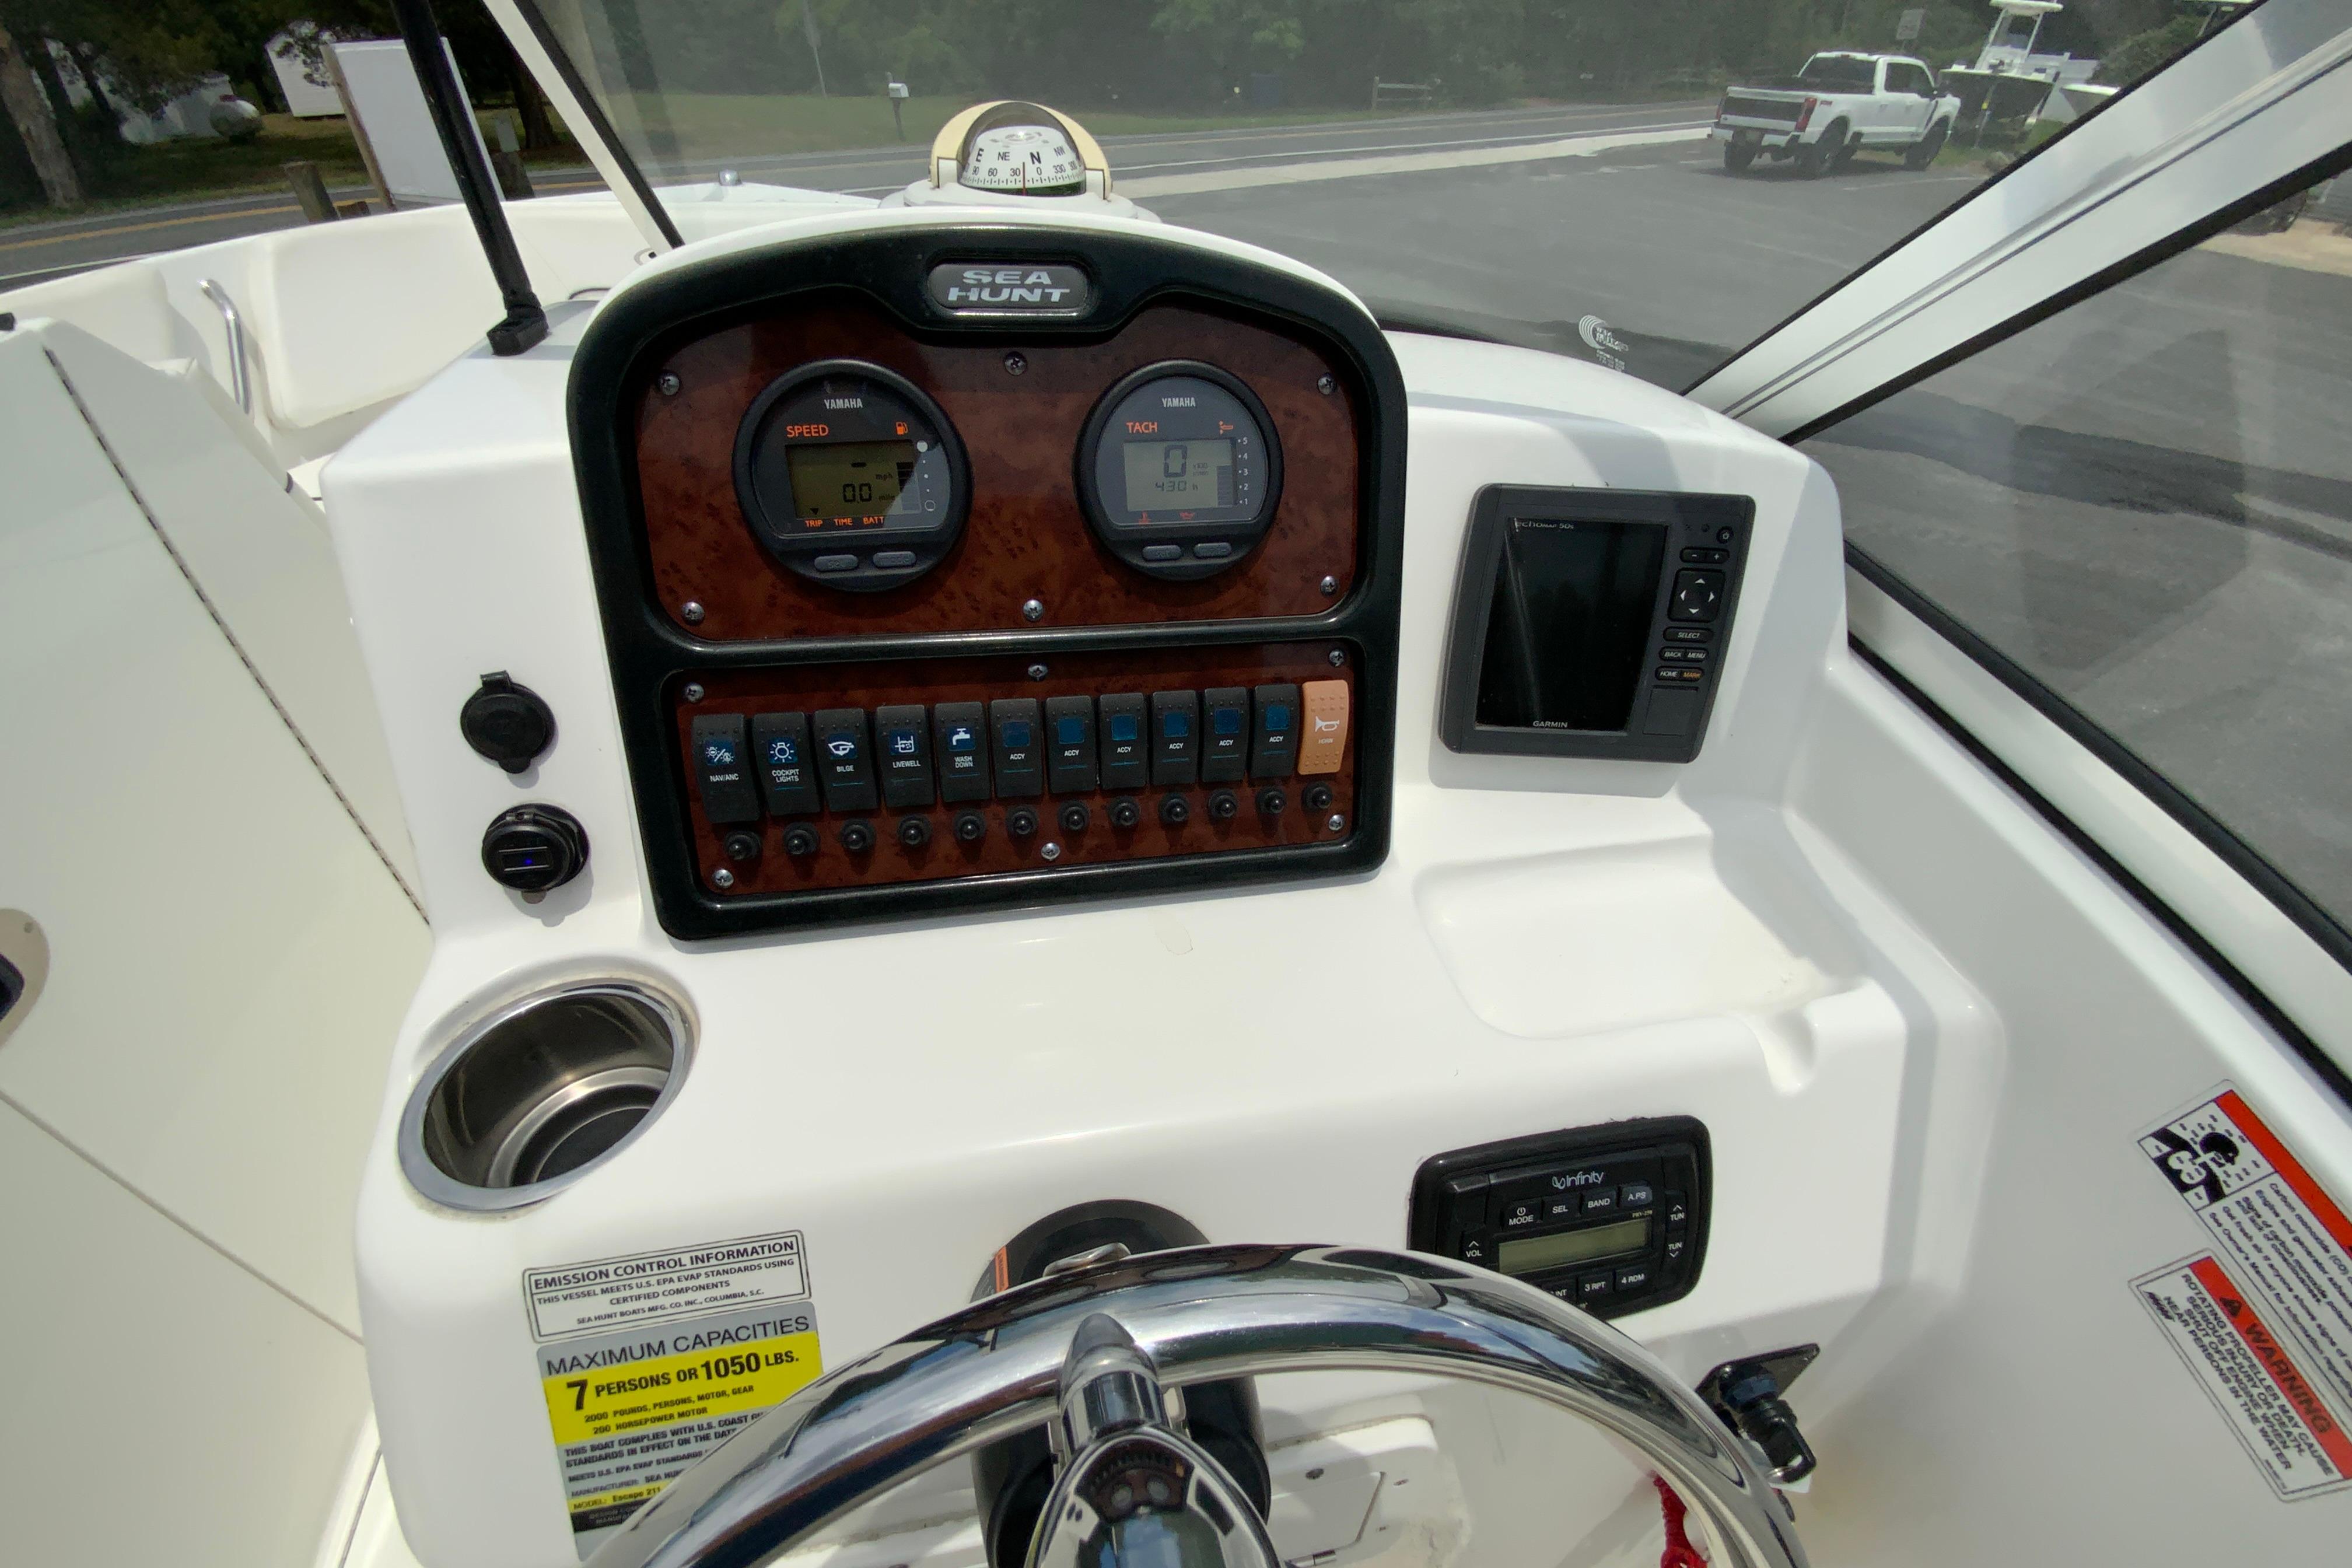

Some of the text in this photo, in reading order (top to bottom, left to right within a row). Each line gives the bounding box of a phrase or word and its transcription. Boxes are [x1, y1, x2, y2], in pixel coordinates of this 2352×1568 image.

[975, 146, 1066, 164] E NE N NW
[972, 166, 979, 176] 90
[988, 168, 998, 177] 60
[1010, 168, 1021, 177] 30
[1037, 167, 1042, 176] 0
[1053, 164, 1066, 174] 330
[963, 270, 1052, 285] SEA
[947, 287, 1070, 302] HUNT
[824, 398, 863, 409] YAMAHA
[1162, 397, 1196, 407] YAMAHA
[786, 424, 829, 438] SPEED
[1126, 421, 1157, 433] TACH
[843, 483, 872, 503] 0.0
[1155, 481, 1187, 492] 430
[805, 516, 884, 527] TRIP TIME BATT
[710, 774, 739, 782] NAV/ANC
[1552, 1205, 1568, 1214] SEL
[1588, 1198, 1610, 1208] BAND
[1508, 1214, 1534, 1226] MODE
[1671, 1212, 1685, 1222] TUN
[1465, 1250, 1482, 1258] VOL
[1668, 1242, 1682, 1251] TUN
[535, 1241, 793, 1289] EMISSION CONTROL INFORMATION
[537, 1259, 794, 1304] THIS VESSEL MEETS U.S. EPA EVAP STANDARDS USING
[1621, 1273, 1645, 1284] 4 RDM
[610, 1280, 730, 1305] CERTIFIED COMPONENTS
[1584, 1281, 1606, 1292] 3 RPT
[594, 1312, 617, 1321] HUNT
[620, 1308, 646, 1317] BOATS
[705, 1292, 748, 1303] COLUMBIA,
[547, 1317, 808, 1375] MAXIMUM CAPACITIES
[2182, 1274, 2226, 1329] ROTATING
[2225, 1332, 2280, 1401] PROPELLER
[2278, 1404, 2301, 1428] MAY
[2188, 1297, 2227, 1346] SERIOUS
[2225, 1348, 2259, 1388] INJURY
[2258, 1392, 2274, 1410] OR
[566, 1350, 799, 1410] 7 PERSONS OR 1050 LBS.
[2164, 1297, 2190, 1327] NEAR
[2189, 1330, 2231, 1384] PERSONS
[2229, 1386, 2242, 1398] IN
[2240, 1401, 2261, 1425] THE
[2259, 1427, 2291, 1469] WATER
[2185, 1309, 2211, 1337] SHUT
[2208, 1341, 2230, 1363] OFF
[2227, 1366, 2262, 1410] ENGINE
[2261, 1413, 2290, 1449] WHEN
[2243, 1320, 2333, 1436] WARNING
[584, 1385, 754, 1423] 2000 POUNDS, PERSONS, MOTOR, GEAR
[593, 1407, 707, 1434] 200 HORSEPOWER MOTOR
[565, 1446, 587, 1457] THIS
[590, 1441, 614, 1452] BOAT
[618, 1431, 667, 1446] COMPLIES
[670, 1426, 695, 1436] WITH
[697, 1422, 716, 1432] U.S.
[718, 1415, 748, 1427] COAST
[566, 1433, 711, 1467] STANDARDS IN EFFECT ON THE
